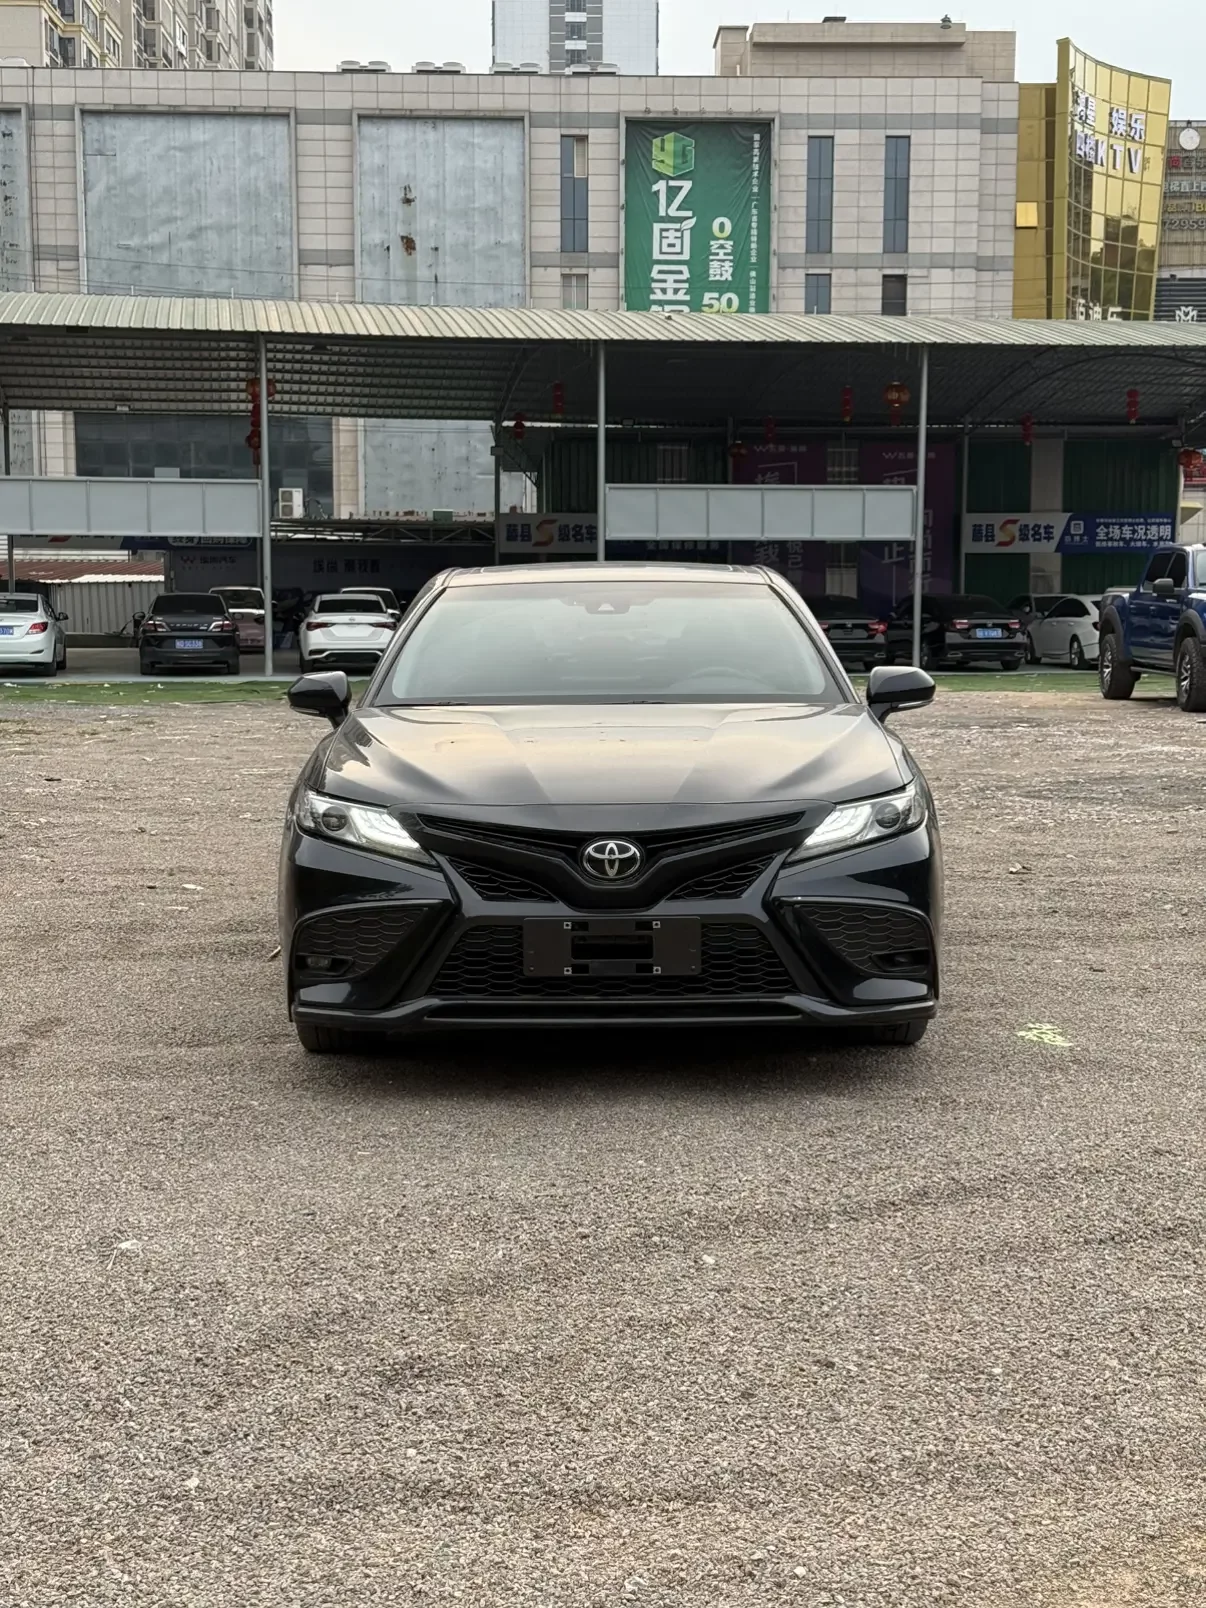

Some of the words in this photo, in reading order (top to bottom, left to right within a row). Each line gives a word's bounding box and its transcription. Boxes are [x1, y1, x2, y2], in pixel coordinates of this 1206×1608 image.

[1111, 107, 1145, 142] 娱乐
[1095, 524, 1172, 541] 全场车况透明
